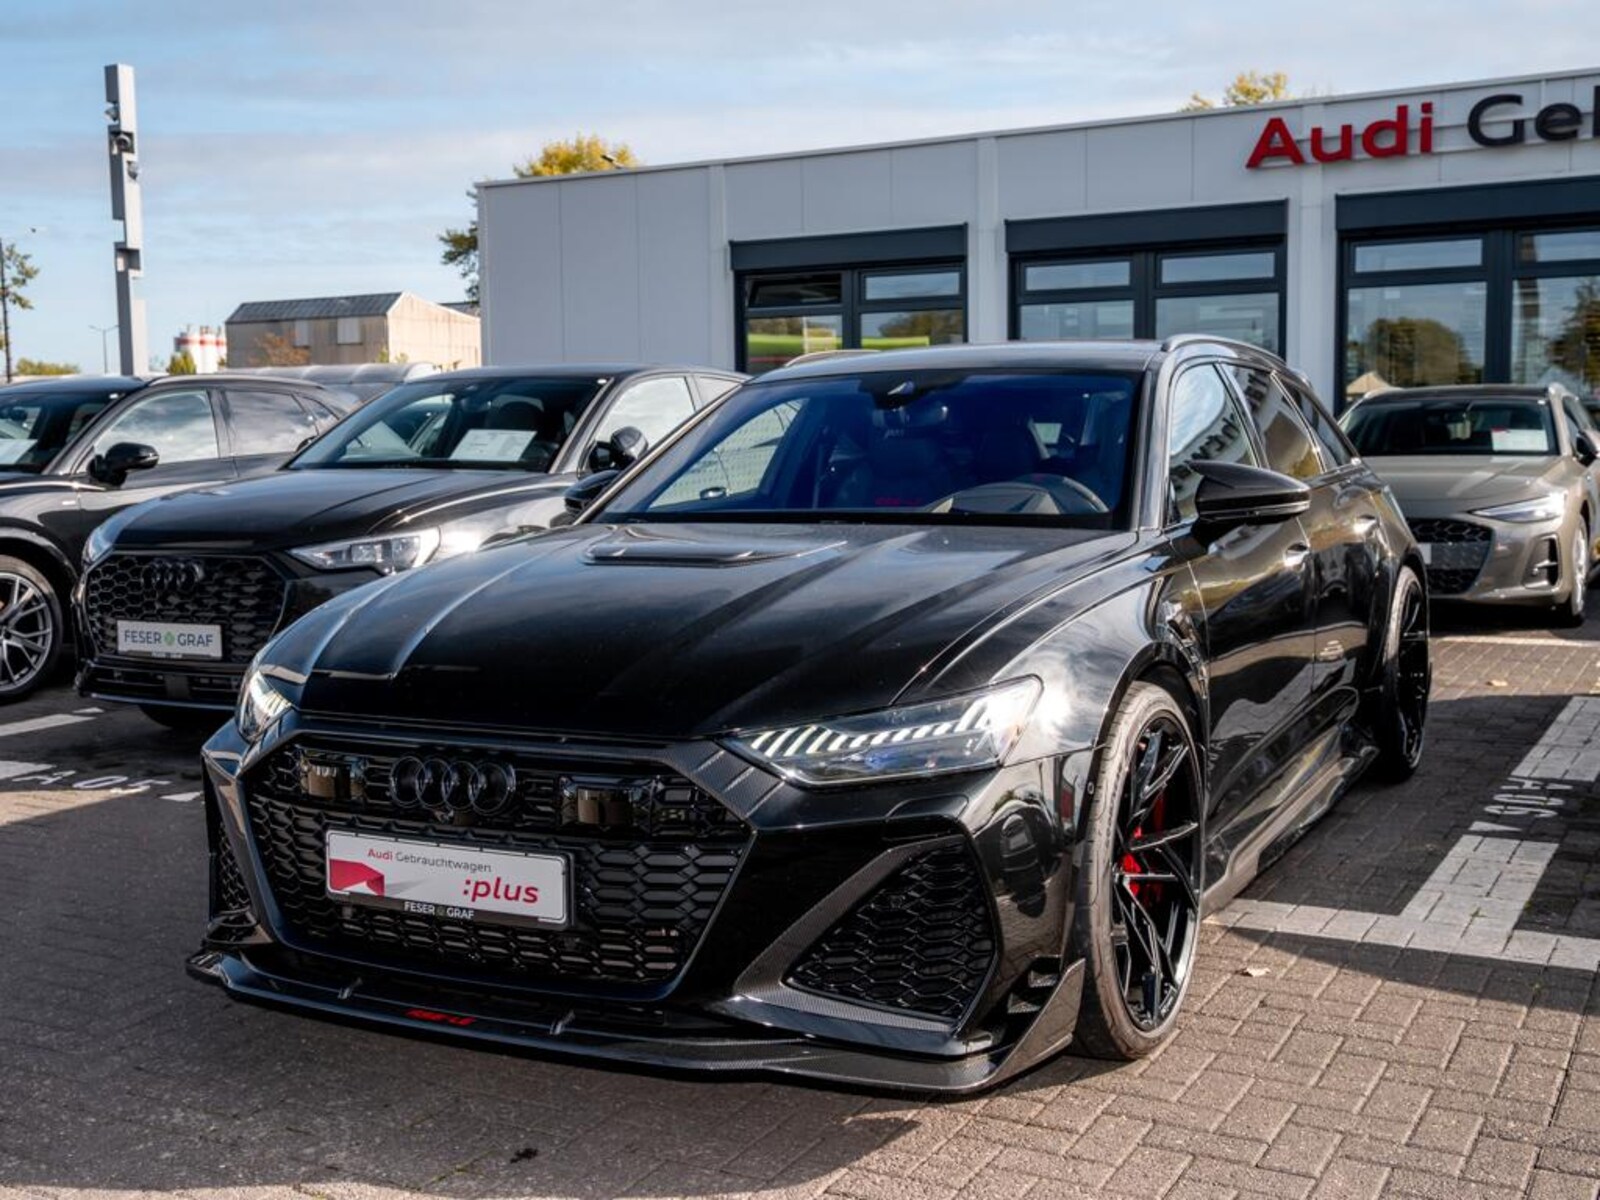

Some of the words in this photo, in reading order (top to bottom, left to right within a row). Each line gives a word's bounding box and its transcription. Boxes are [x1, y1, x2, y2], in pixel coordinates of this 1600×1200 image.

[1246, 102, 1433, 168] Audi
[1467, 86, 1600, 147] Ge
[124, 630, 162, 645] FESER
[177, 633, 213, 648] GRAF
[368, 848, 393, 861] Audi
[396, 851, 492, 873] Gebrauchtwagen
[462, 876, 539, 904] :plus
[404, 901, 435, 916] FESER
[446, 907, 474, 919] GRAF
